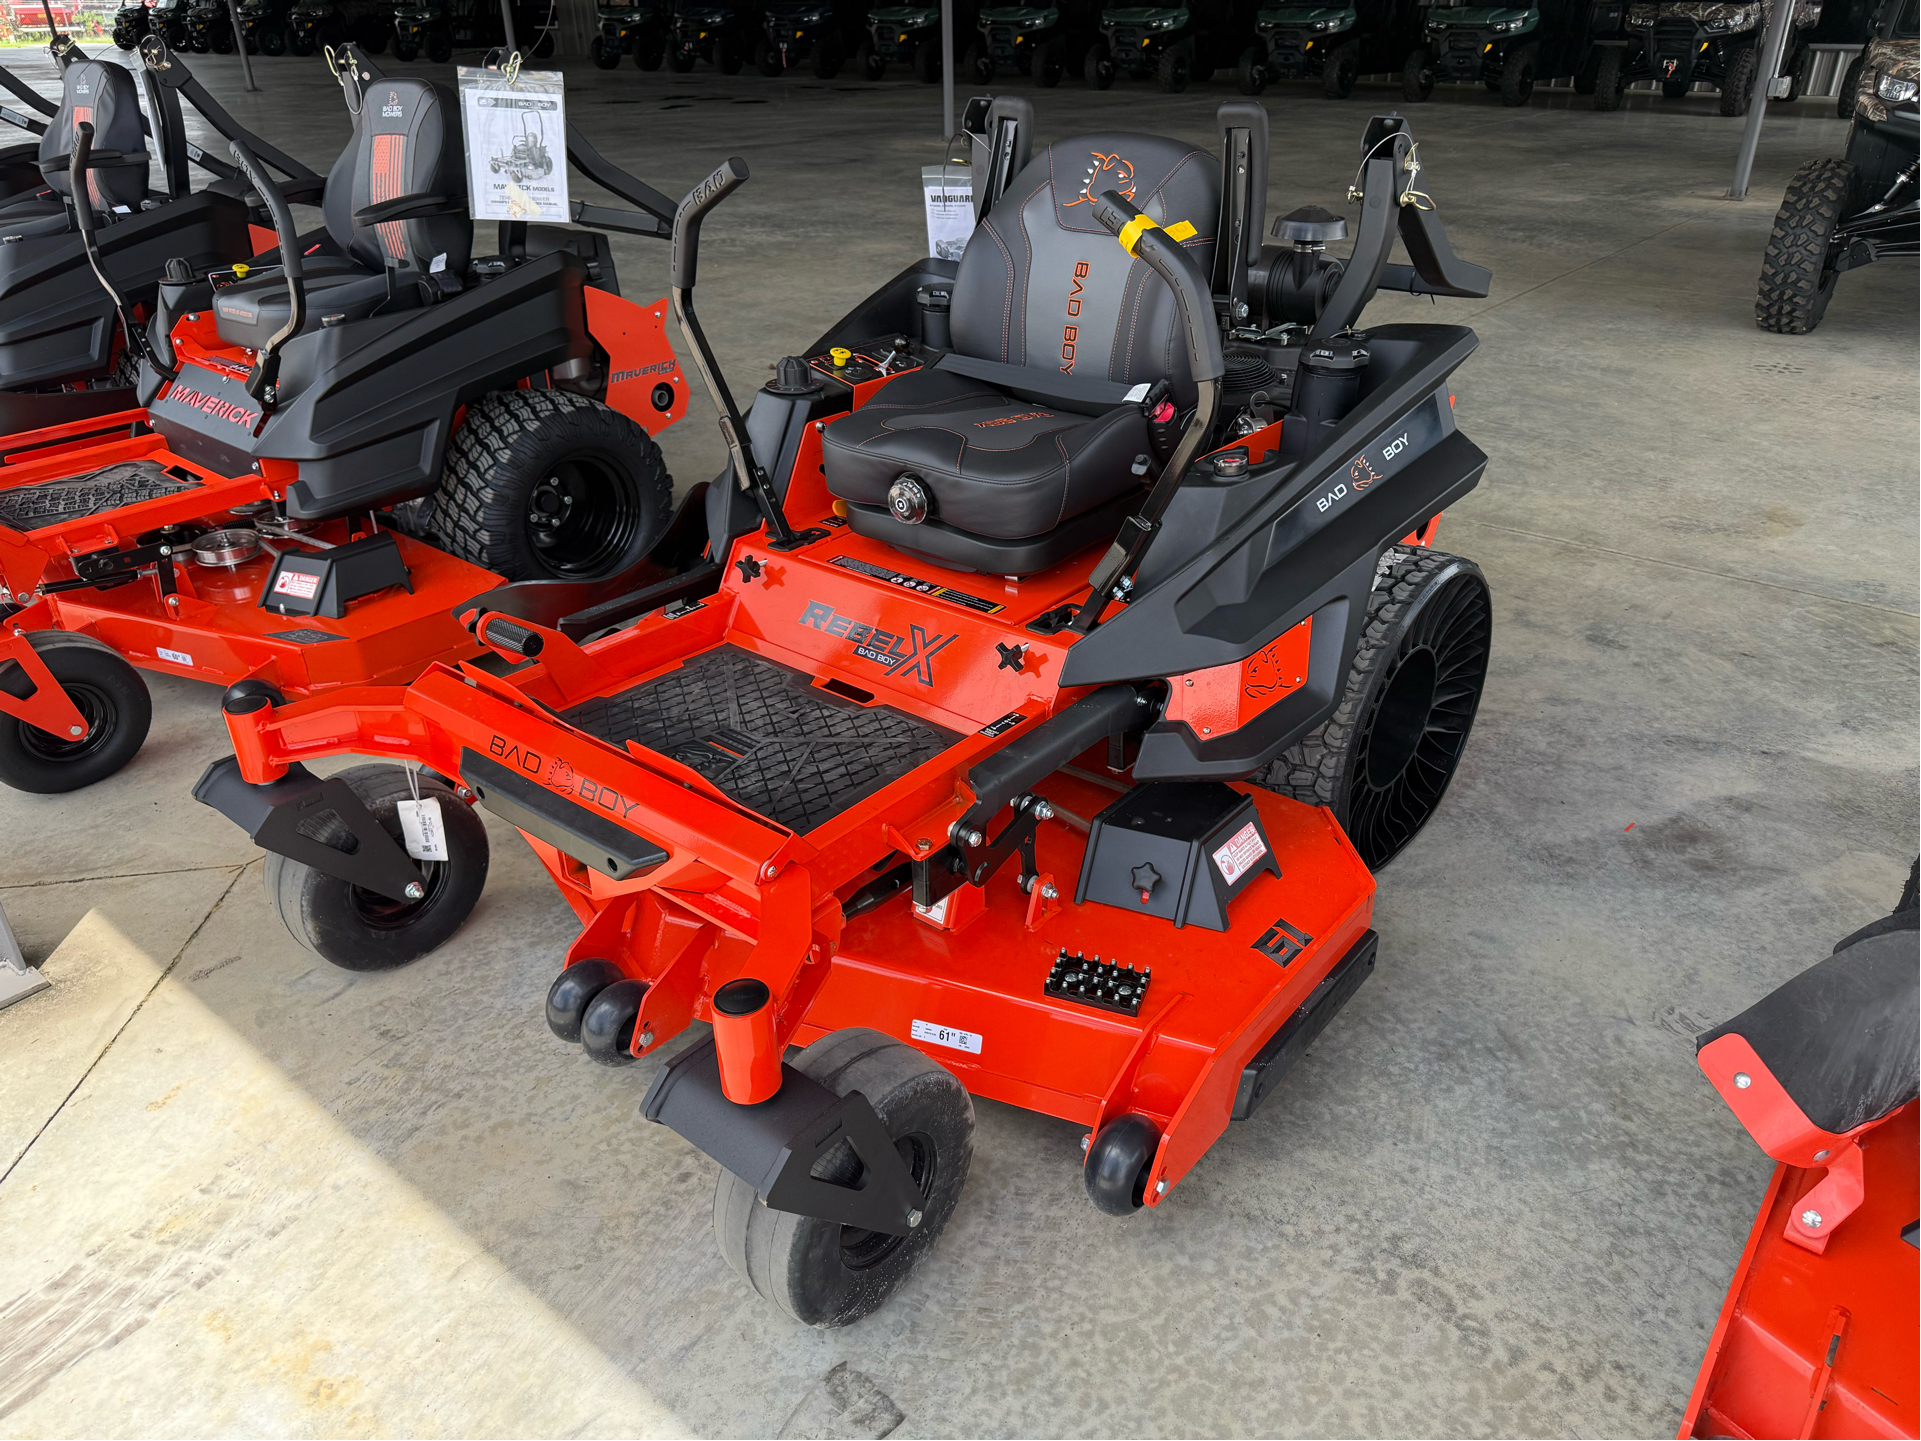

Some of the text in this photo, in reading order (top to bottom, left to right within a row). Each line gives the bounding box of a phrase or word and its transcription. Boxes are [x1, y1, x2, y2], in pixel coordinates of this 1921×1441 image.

[692, 169, 726, 206] BAD
[930, 194, 973, 203] VANGUAR
[1059, 260, 1091, 376] BAD BOY
[610, 358, 677, 384] MAVERICK
[169, 384, 259, 429] MAVERICK
[1316, 432, 1409, 513] BAD BOY
[857, 647, 896, 666] BAD BOY
[489, 734, 640, 820] BAD BOY
[1249, 917, 1315, 969] 61
[938, 1029, 956, 1042] 61"
